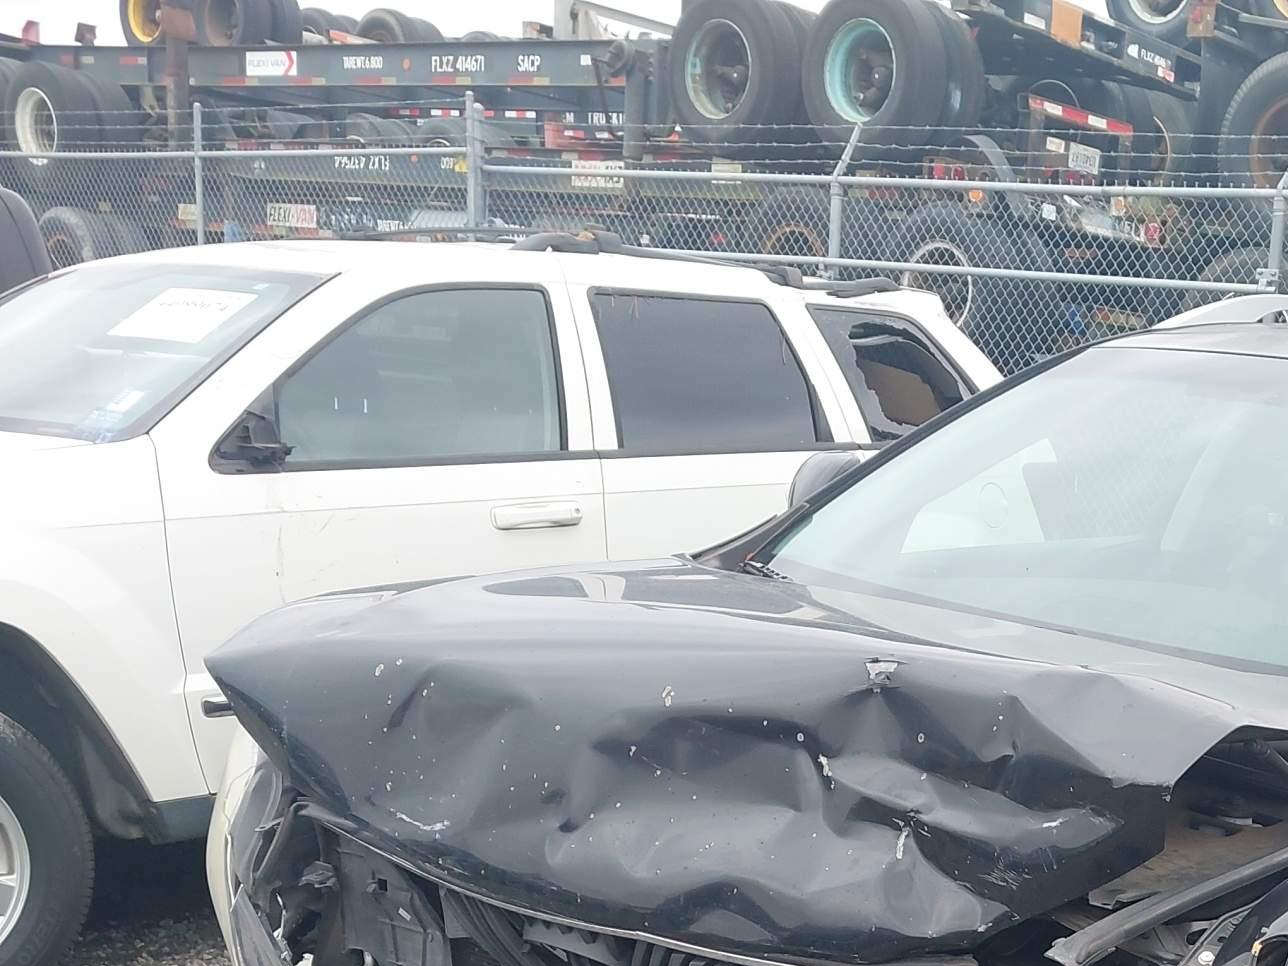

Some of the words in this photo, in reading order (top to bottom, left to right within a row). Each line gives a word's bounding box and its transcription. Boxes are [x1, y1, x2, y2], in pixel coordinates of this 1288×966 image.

[431, 55, 454, 72] FLXZ
[456, 55, 485, 72] 414671
[517, 55, 541, 72] SACP
